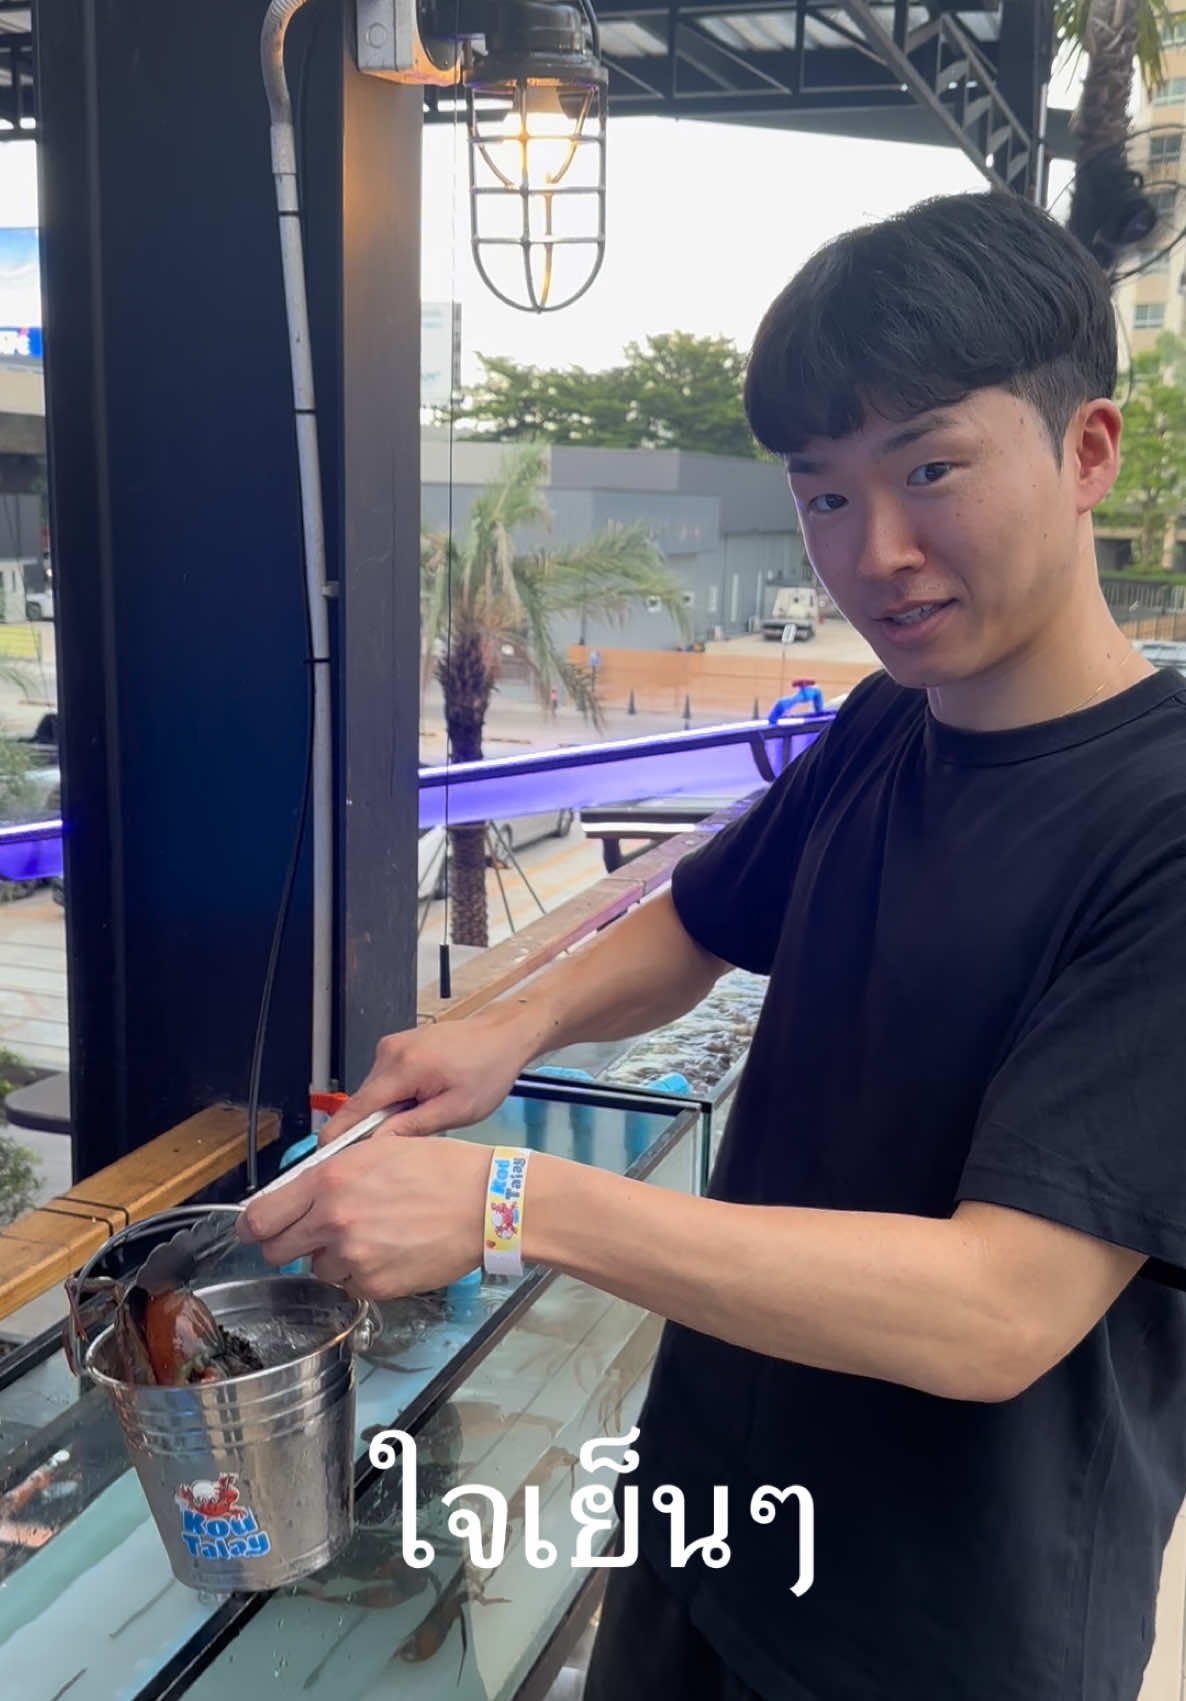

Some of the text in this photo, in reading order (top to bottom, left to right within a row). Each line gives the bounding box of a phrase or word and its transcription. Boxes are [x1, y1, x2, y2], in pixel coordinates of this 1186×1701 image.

[504, 1157, 526, 1200] Talay
[182, 1504, 259, 1539] Kou
[181, 1531, 271, 1560] Talay
